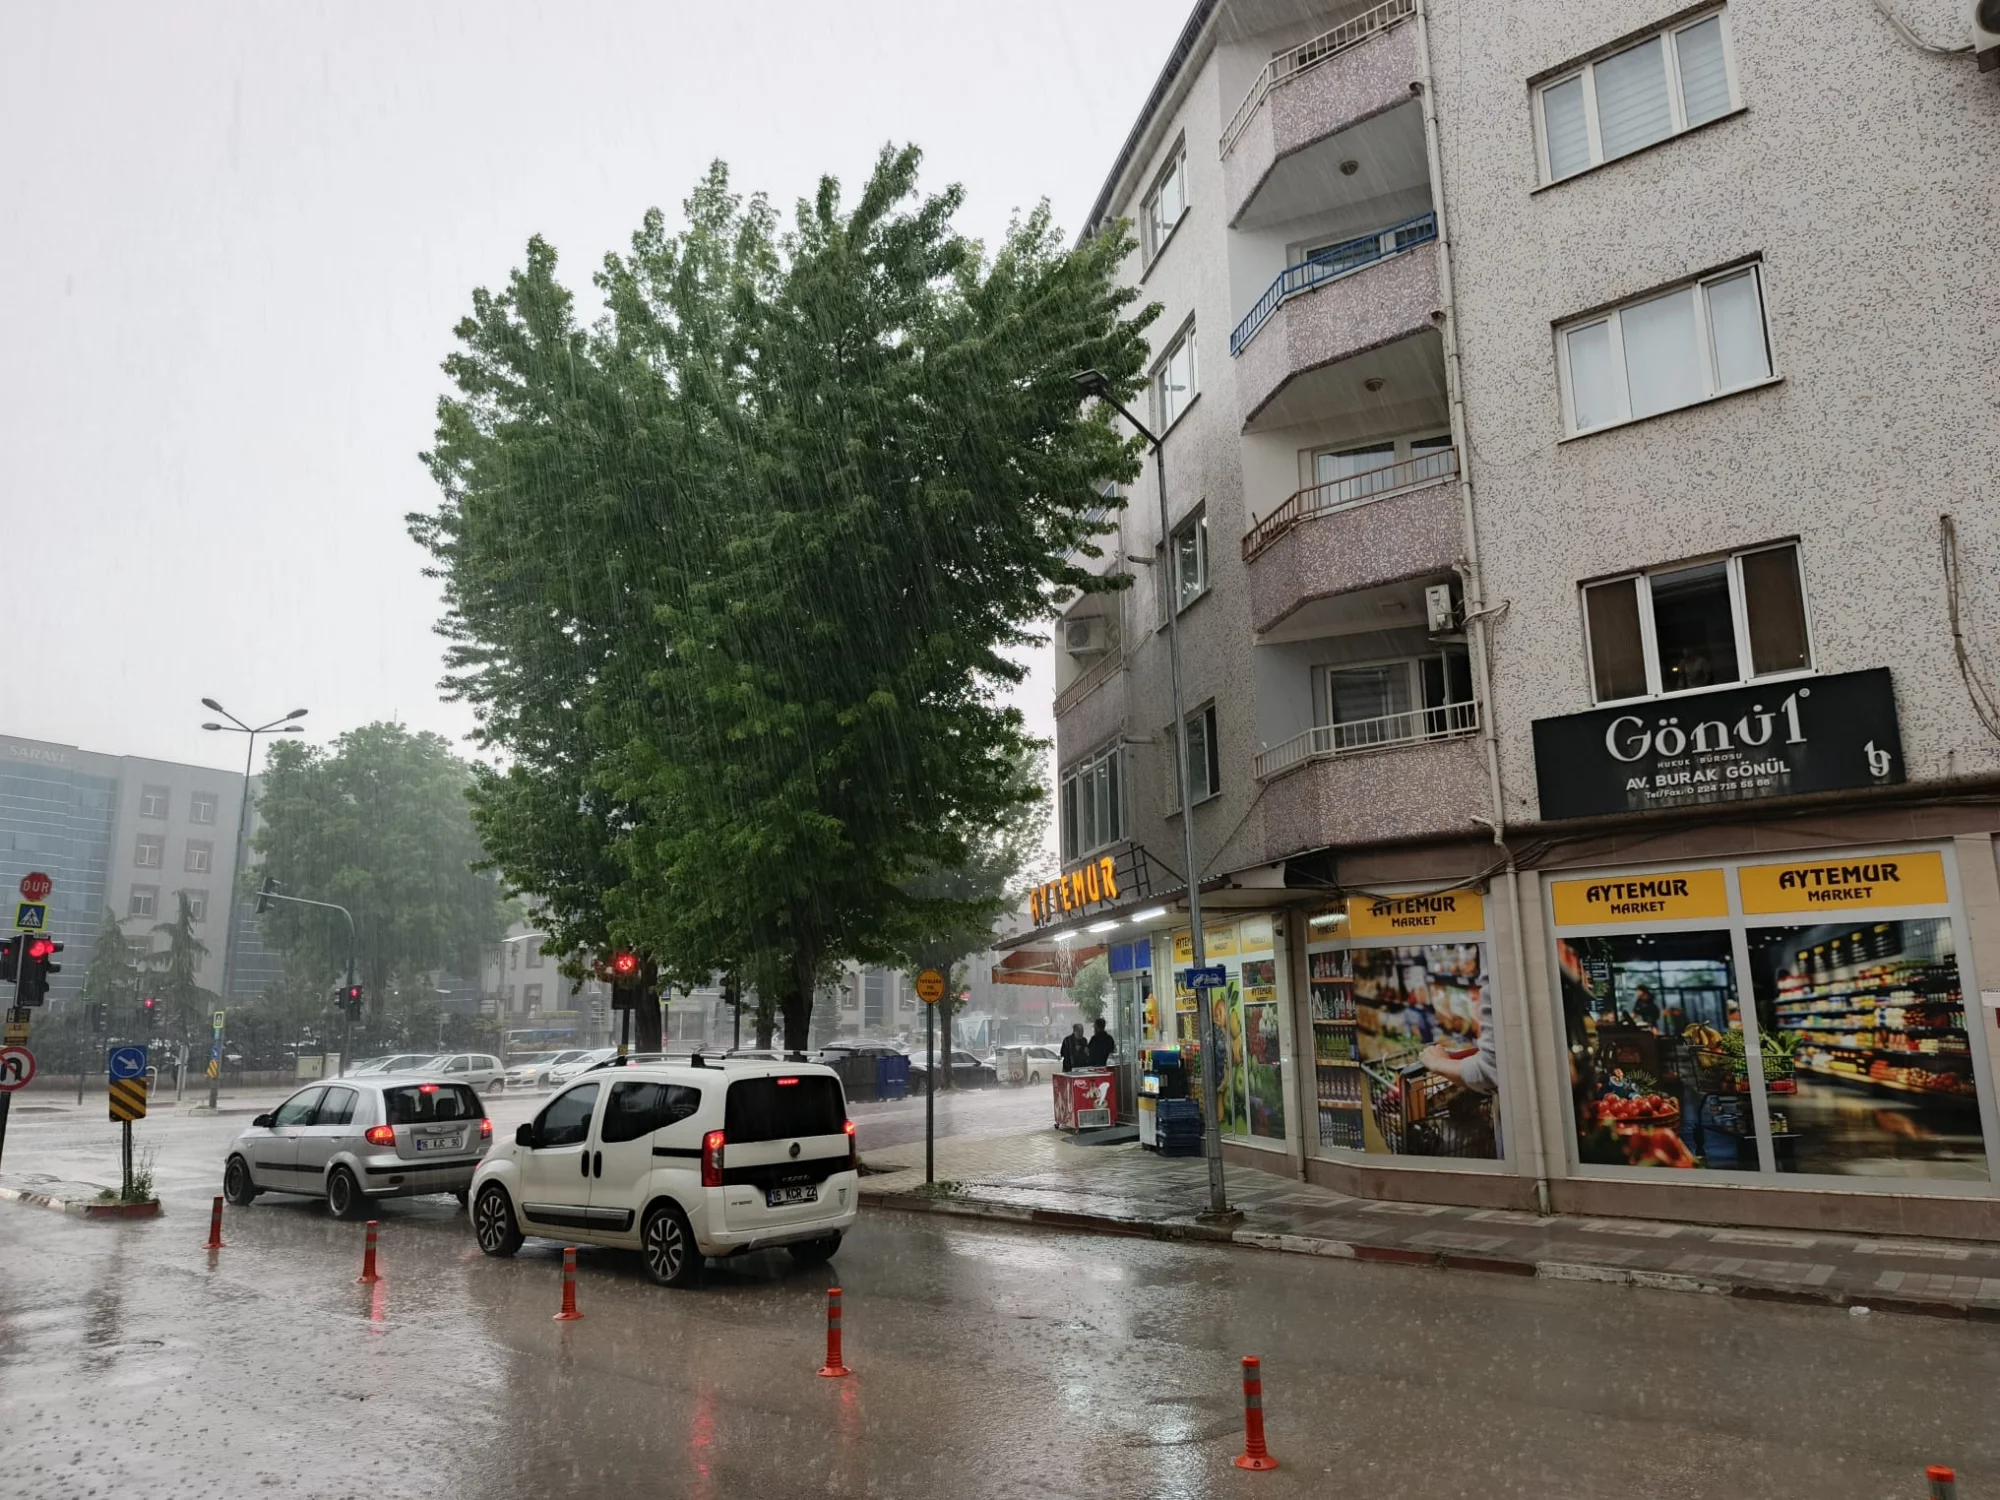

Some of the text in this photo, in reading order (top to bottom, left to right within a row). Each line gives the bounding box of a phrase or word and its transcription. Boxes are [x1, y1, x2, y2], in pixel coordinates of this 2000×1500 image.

[1657, 758, 1691, 769] HUKUK
[1626, 757, 1791, 791] AV. BURAK GÖNÜL
[1697, 783, 1717, 793] 224
[1779, 863, 1901, 890] AYTEMUR
[23, 880, 50, 894] DUR
[1030, 857, 1117, 922] AYTEMUR
[1586, 879, 1689, 903] AYTEMUR
[1807, 887, 1873, 902] MARKET
[1372, 896, 1456, 917] AYTEMUR
[1610, 901, 1665, 915] MARKET
[1391, 916, 1437, 928] MARKET
[772, 1186, 817, 1201] 16 KCR 22
